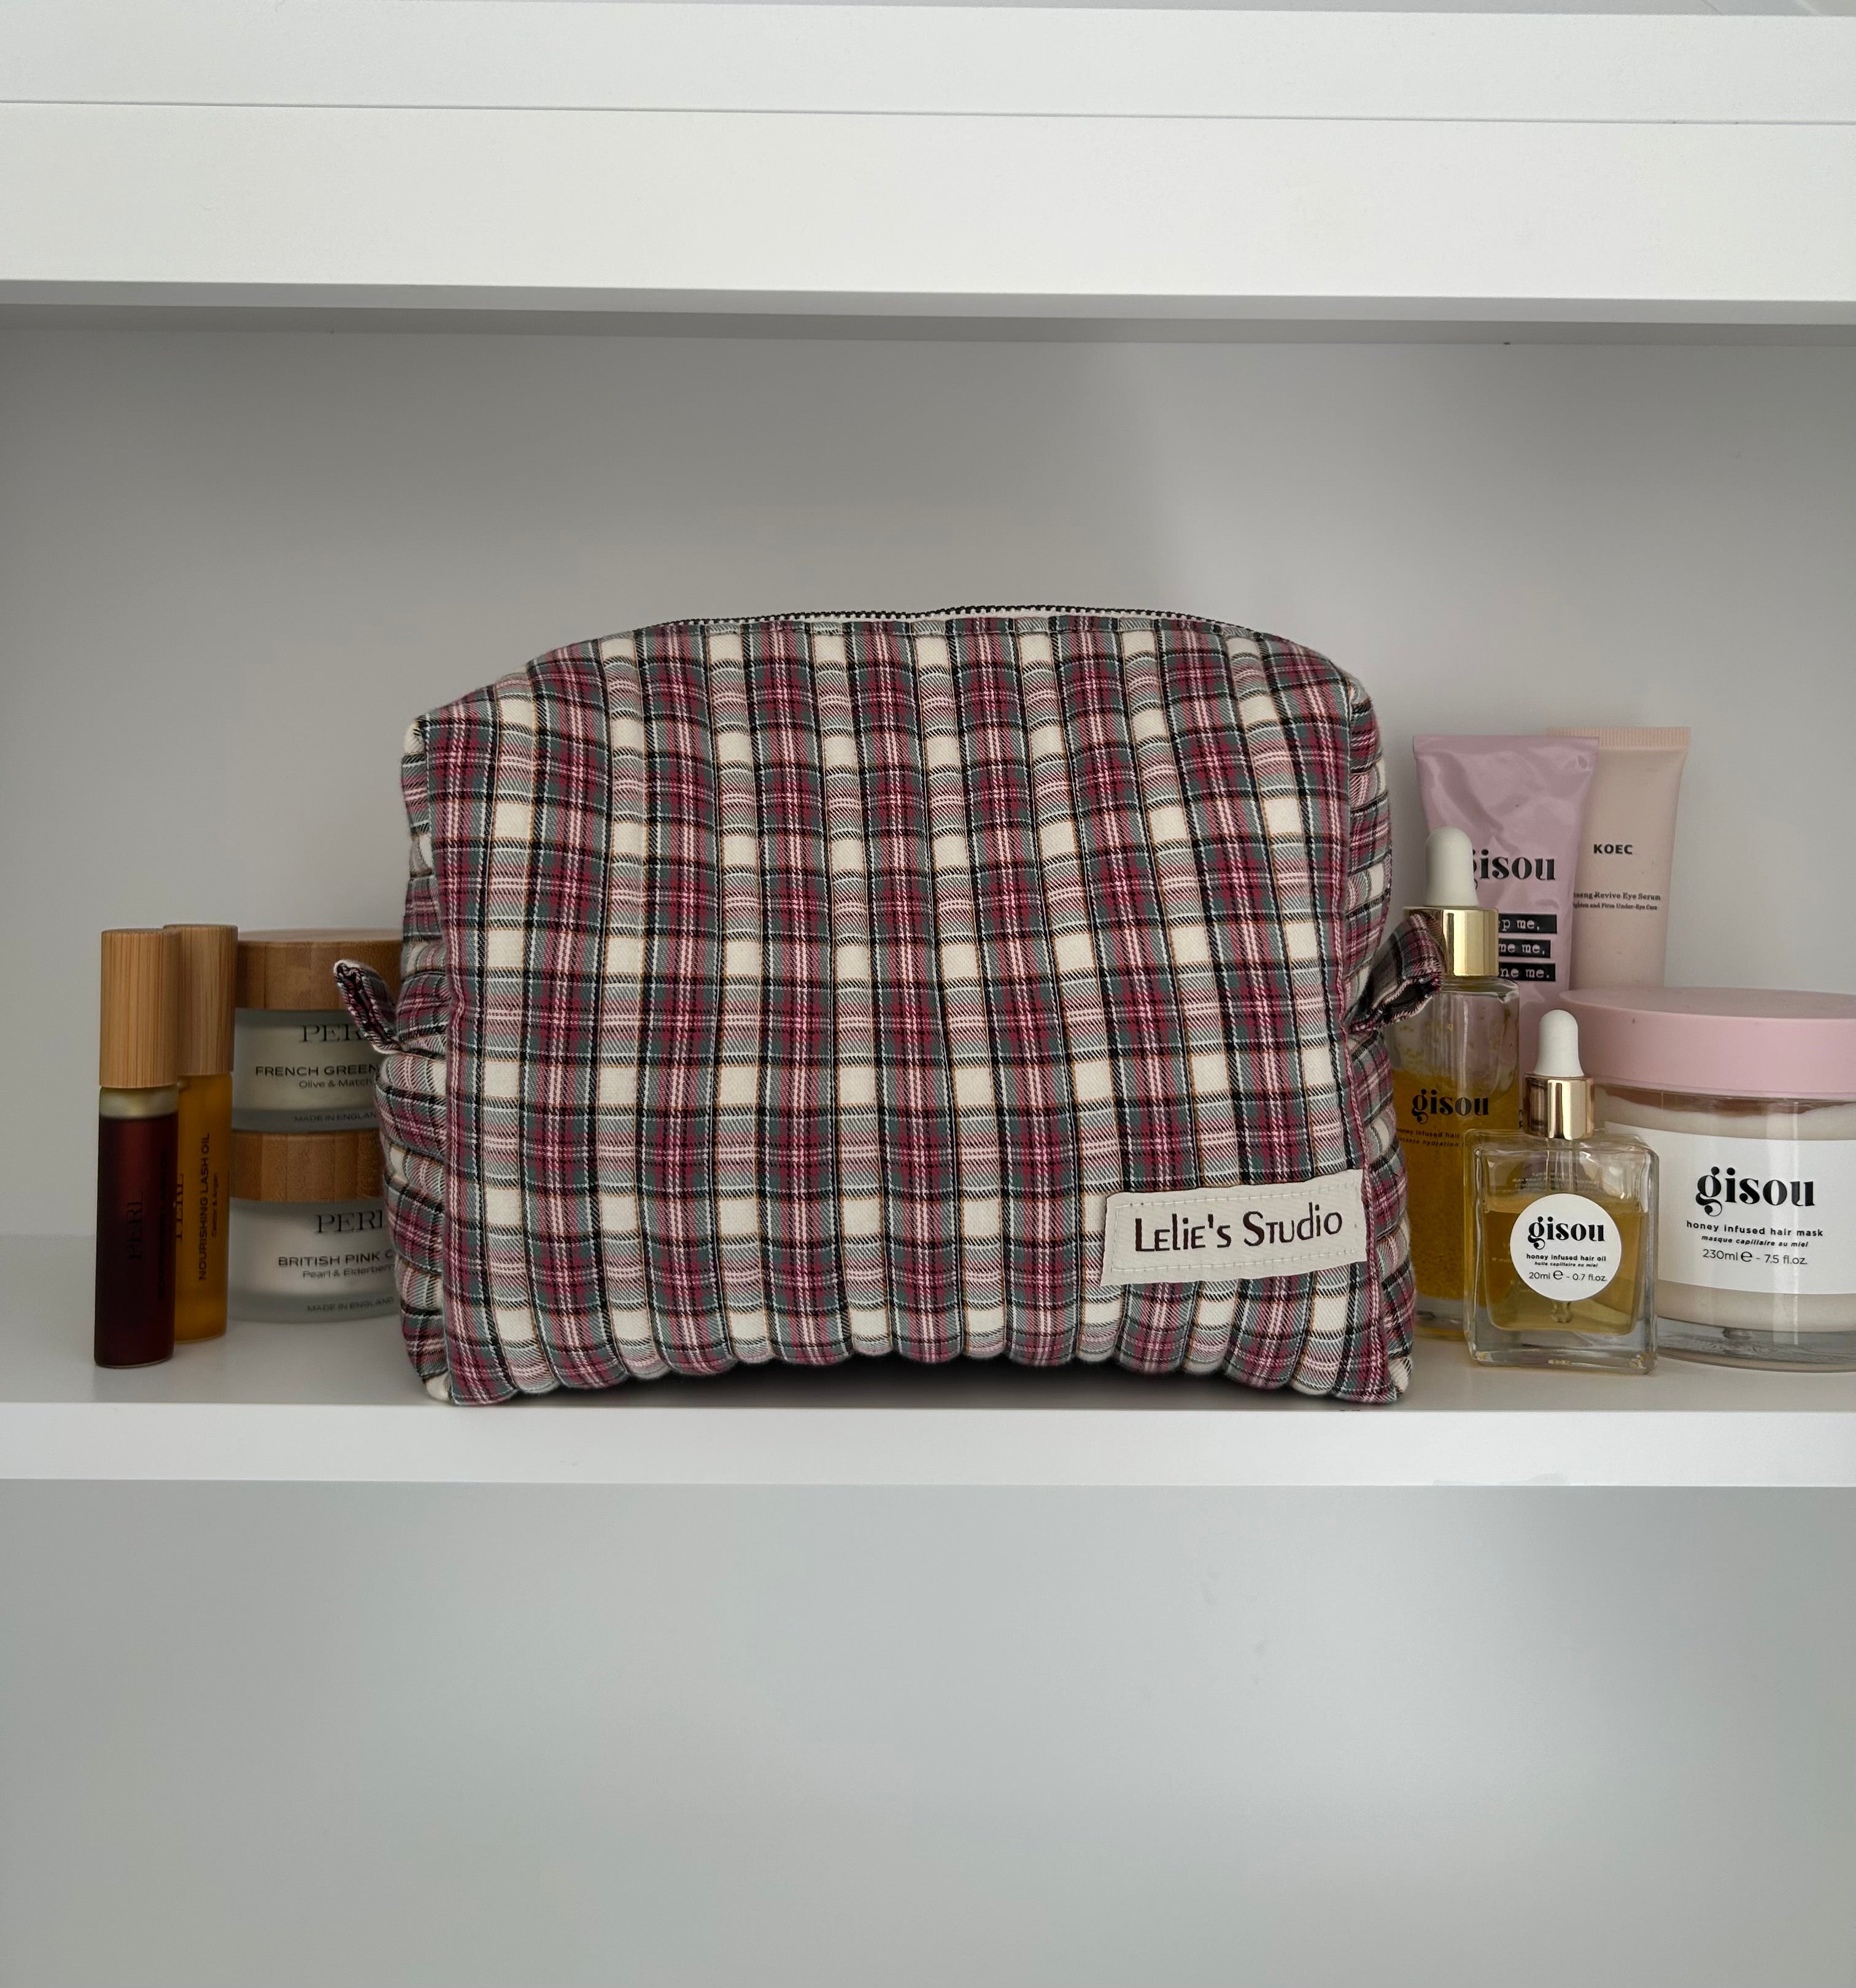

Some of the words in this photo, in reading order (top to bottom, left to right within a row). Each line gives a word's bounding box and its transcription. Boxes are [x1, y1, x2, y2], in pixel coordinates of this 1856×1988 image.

[1593, 844, 1633, 854] KOEC
[1473, 849, 1556, 890] isou
[1516, 919, 1540, 930] me,
[1522, 944, 1545, 955] me,
[1526, 969, 1550, 978] me.
[255, 1066, 319, 1076] FRENCH
[324, 1064, 377, 1076] GREEN
[300, 1080, 325, 1089] Olive
[1412, 1089, 1490, 1124] gisou
[1416, 1129, 1442, 1138] infused
[201, 1132, 210, 1155] OIL
[200, 1158, 209, 1193] LASH
[1695, 1166, 1815, 1217] gisou
[1528, 1216, 1606, 1250] gisou
[1686, 1220, 1719, 1232] honey
[1724, 1224, 1766, 1235] infused
[1771, 1227, 1792, 1236] hair
[1796, 1228, 1823, 1237] mask
[198, 1197, 209, 1281] NOURISHING
[1701, 1235, 1733, 1244] masque
[1736, 1239, 1776, 1247] capillaire
[278, 1256, 340, 1267] BRITISH
[344, 1252, 381, 1265] PINK
[1703, 1248, 1738, 1262] 230ml
[303, 1270, 331, 1279] Pearl
[333, 1269, 340, 1277] &
[307, 1304, 336, 1312] MADE
[338, 1302, 348, 1311] IN
[349, 1296, 395, 1309] ENGLAND
